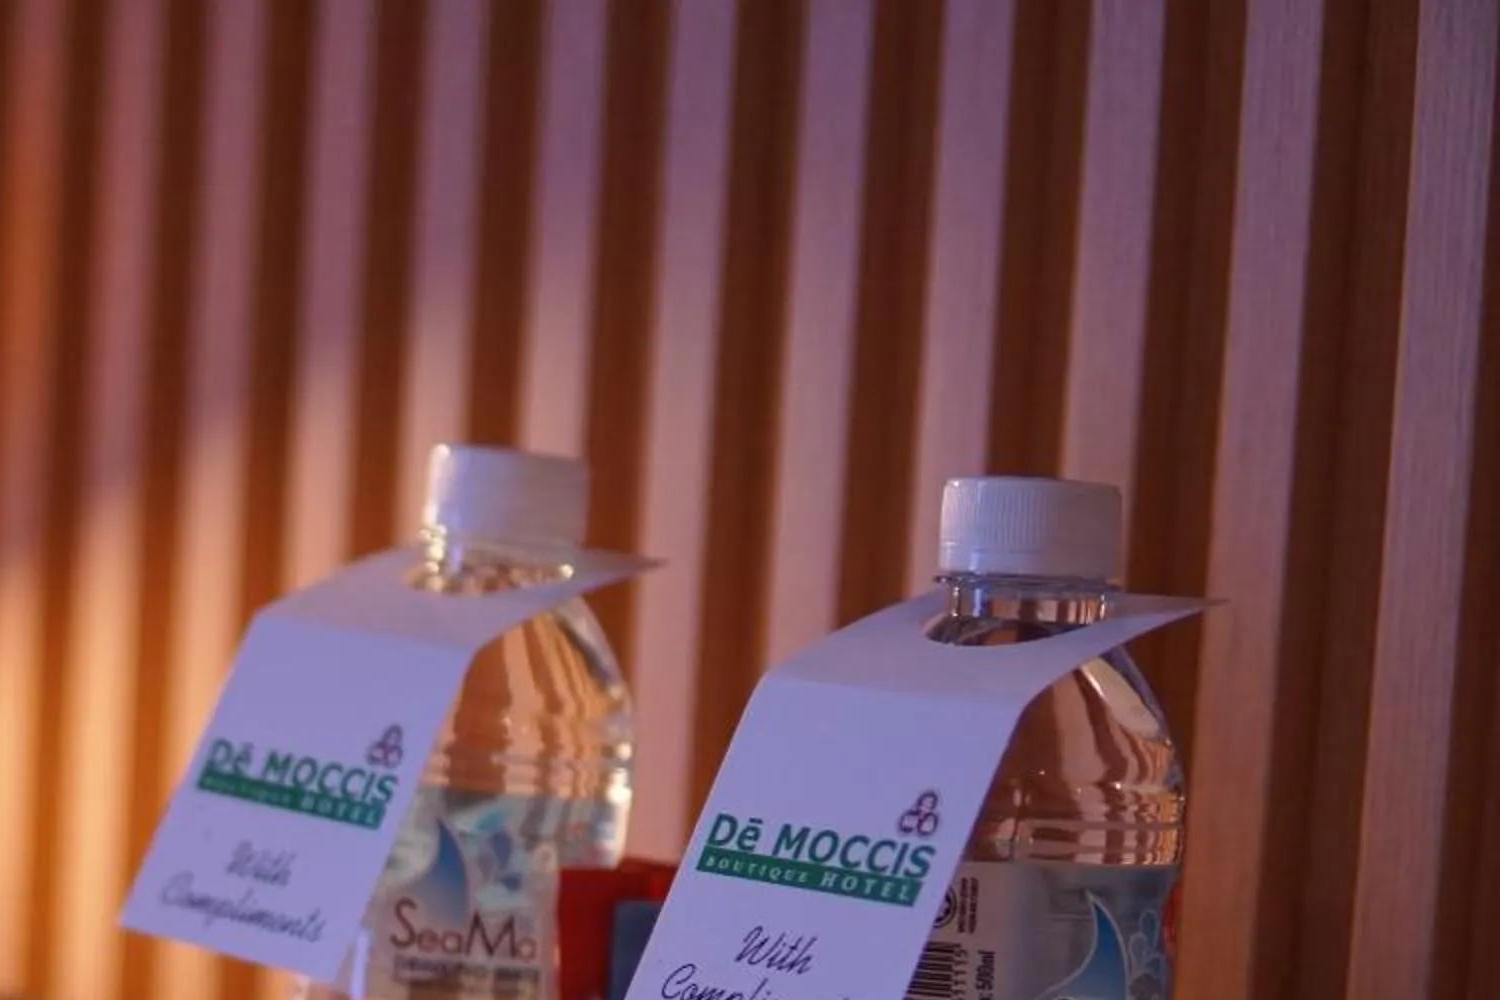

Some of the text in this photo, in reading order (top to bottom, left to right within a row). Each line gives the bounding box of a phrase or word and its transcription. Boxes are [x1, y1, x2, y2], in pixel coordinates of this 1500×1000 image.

[263, 750, 399, 805] MOCCIS
[771, 823, 936, 879] MOCCIS
[705, 855, 911, 901] BOUTIQUE HOTEL
[734, 924, 815, 975] With
